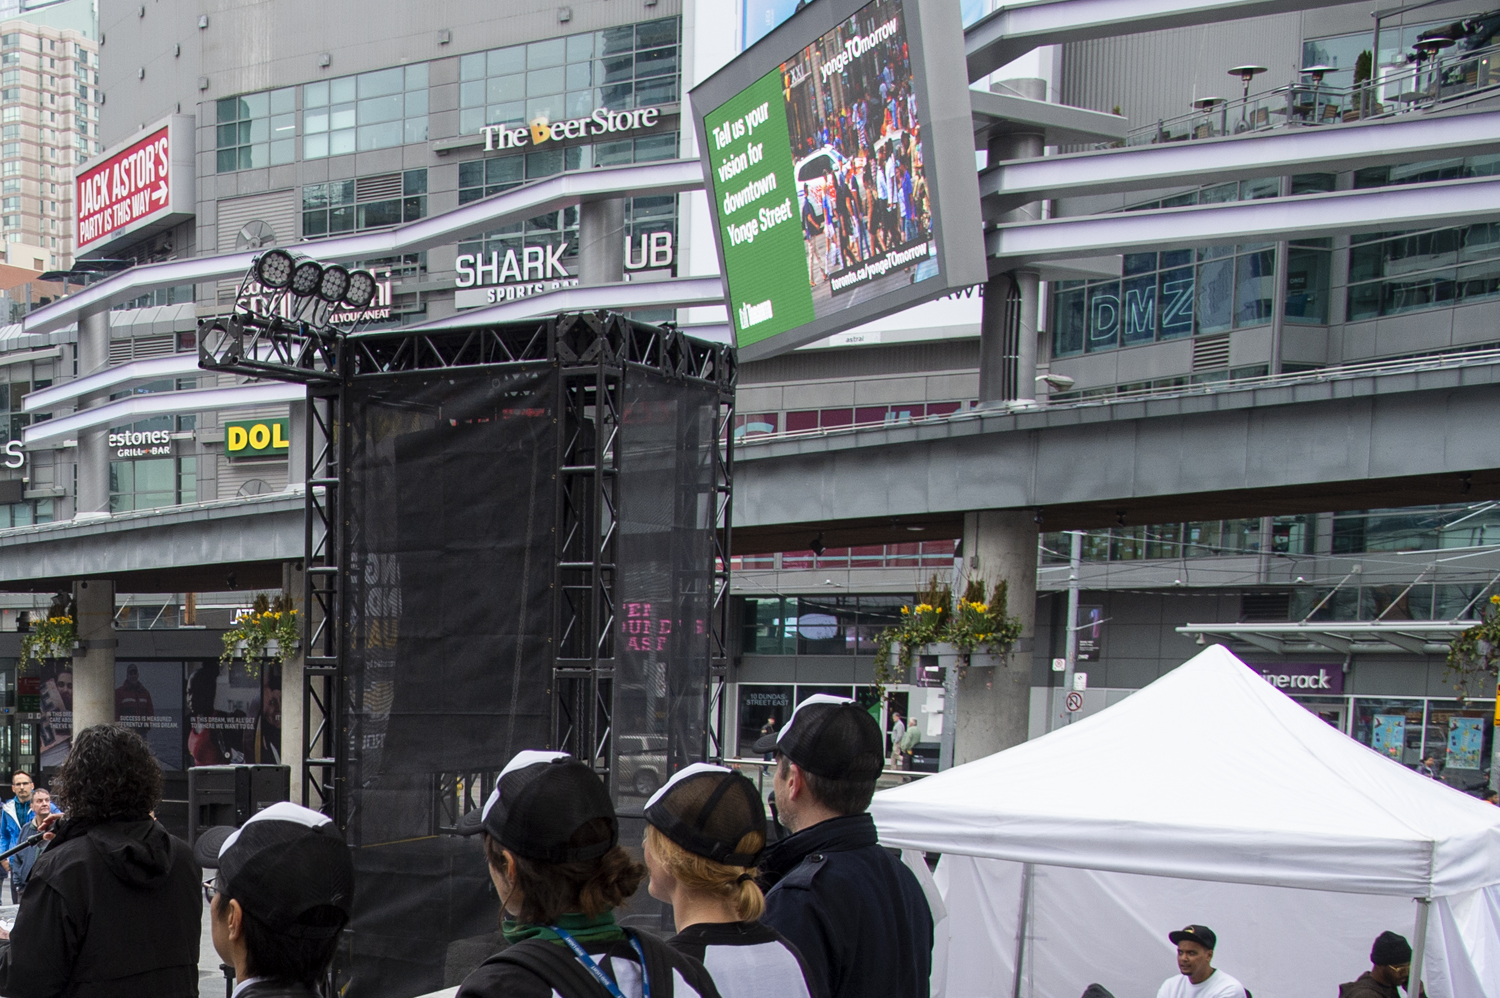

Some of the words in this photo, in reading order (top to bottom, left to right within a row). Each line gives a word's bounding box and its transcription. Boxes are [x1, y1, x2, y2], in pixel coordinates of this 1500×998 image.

[820, 17, 897, 83] yongeTOmorrow
[479, 124, 528, 151] The
[529, 115, 591, 146] Beer
[591, 107, 659, 135] Store
[712, 121, 733, 150] Tell
[731, 118, 746, 140] us
[744, 101, 769, 136] your
[80, 168, 110, 218] JACK
[112, 136, 168, 202] ASTOR'S
[718, 153, 749, 183] vision
[747, 142, 763, 166] for
[80, 211, 103, 244] PARTY
[104, 208, 112, 232] IS
[112, 198, 131, 227] THIS
[131, 187, 151, 218] WAY
[723, 172, 777, 215] downtown
[727, 218, 759, 246] Yonge
[758, 197, 793, 232] Street
[455, 243, 570, 287] SHARK
[625, 232, 674, 269] UB
[487, 284, 543, 303] SPORTS
[1091, 277, 1194, 340] DMZ
[845, 335, 864, 343] astral
[109, 430, 170, 447] estones
[117, 447, 143, 457] GRILL
[151, 446, 170, 455] BAR
[228, 423, 290, 452] DOL
